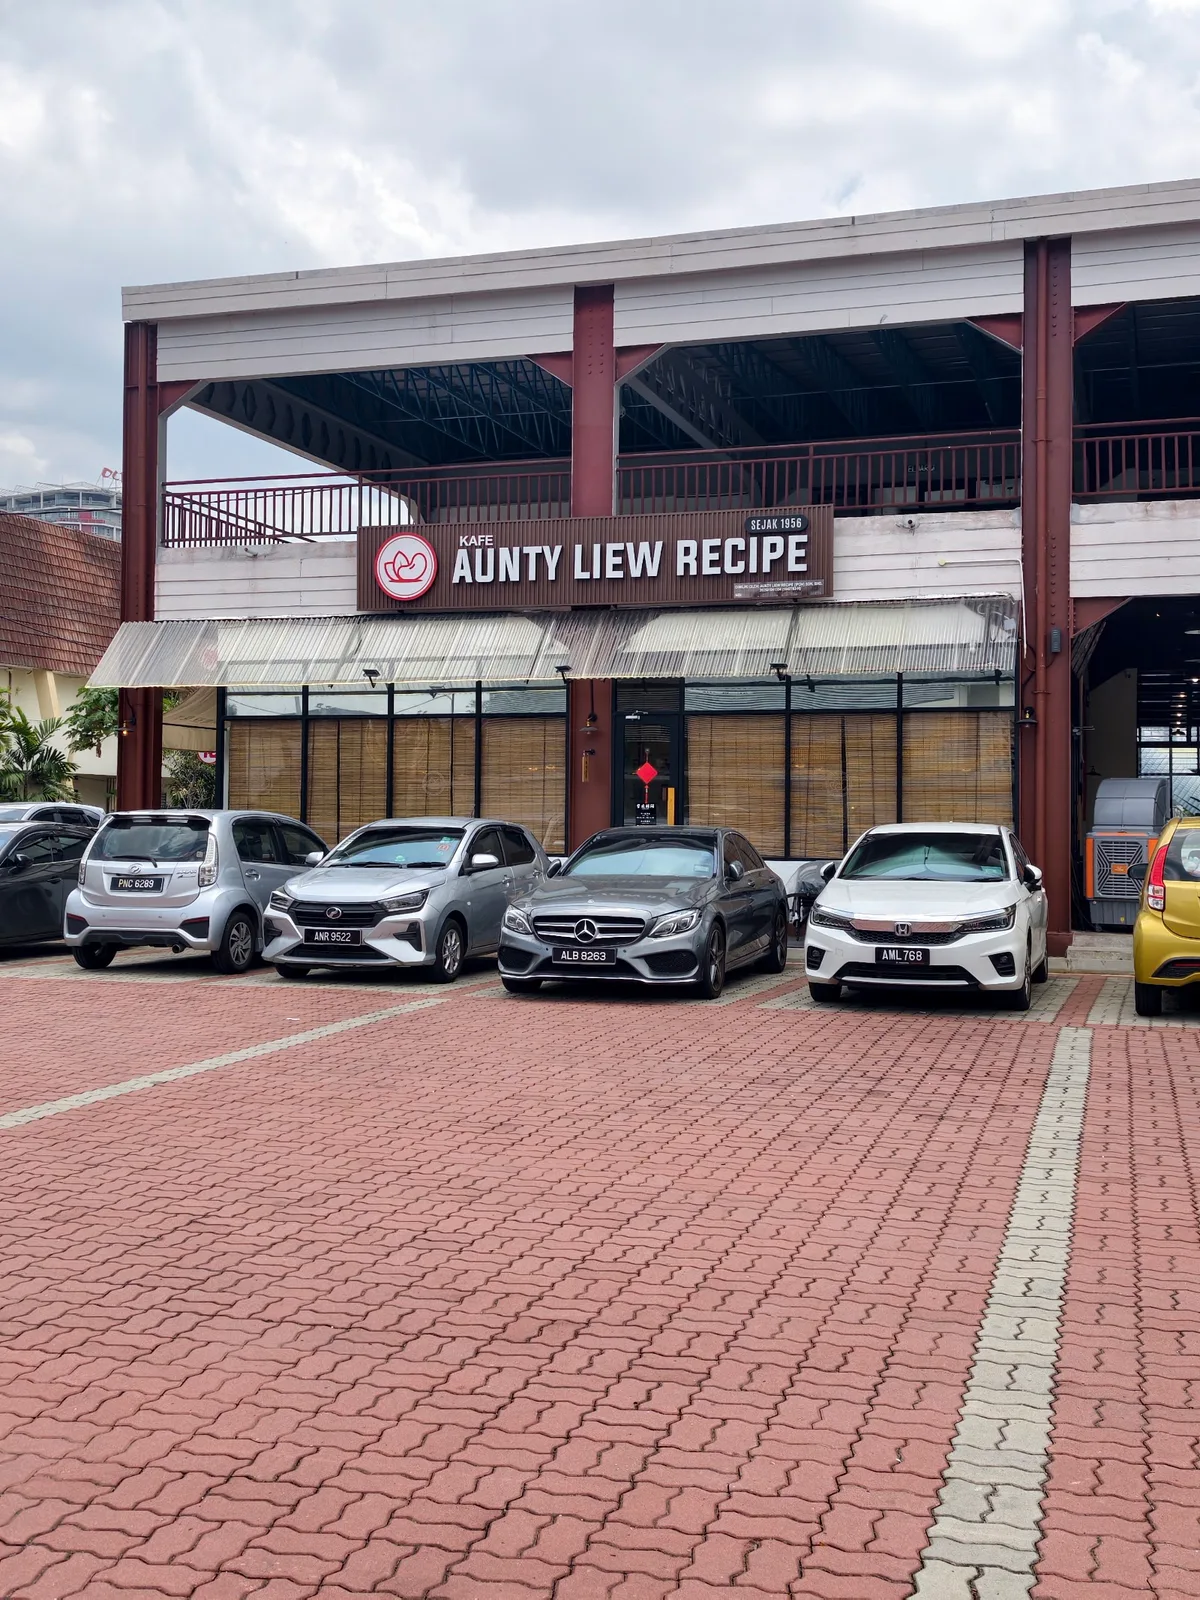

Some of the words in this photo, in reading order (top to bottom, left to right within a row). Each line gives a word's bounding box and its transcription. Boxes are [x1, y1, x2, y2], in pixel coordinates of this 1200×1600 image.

[750, 519, 778, 530] SEJAK
[780, 517, 802, 529] 1956
[460, 535, 494, 546] KAFE
[452, 545, 563, 584] AUNTY
[574, 540, 663, 579] LIEW
[676, 534, 808, 576] RECIPE
[118, 879, 133, 888] PNC
[134, 879, 154, 888] 6289
[314, 931, 330, 941] ANR
[330, 931, 351, 942] 9522
[560, 950, 579, 960] ALB
[580, 951, 606, 961] 8263
[882, 949, 903, 961] AML
[903, 950, 923, 961] 768
